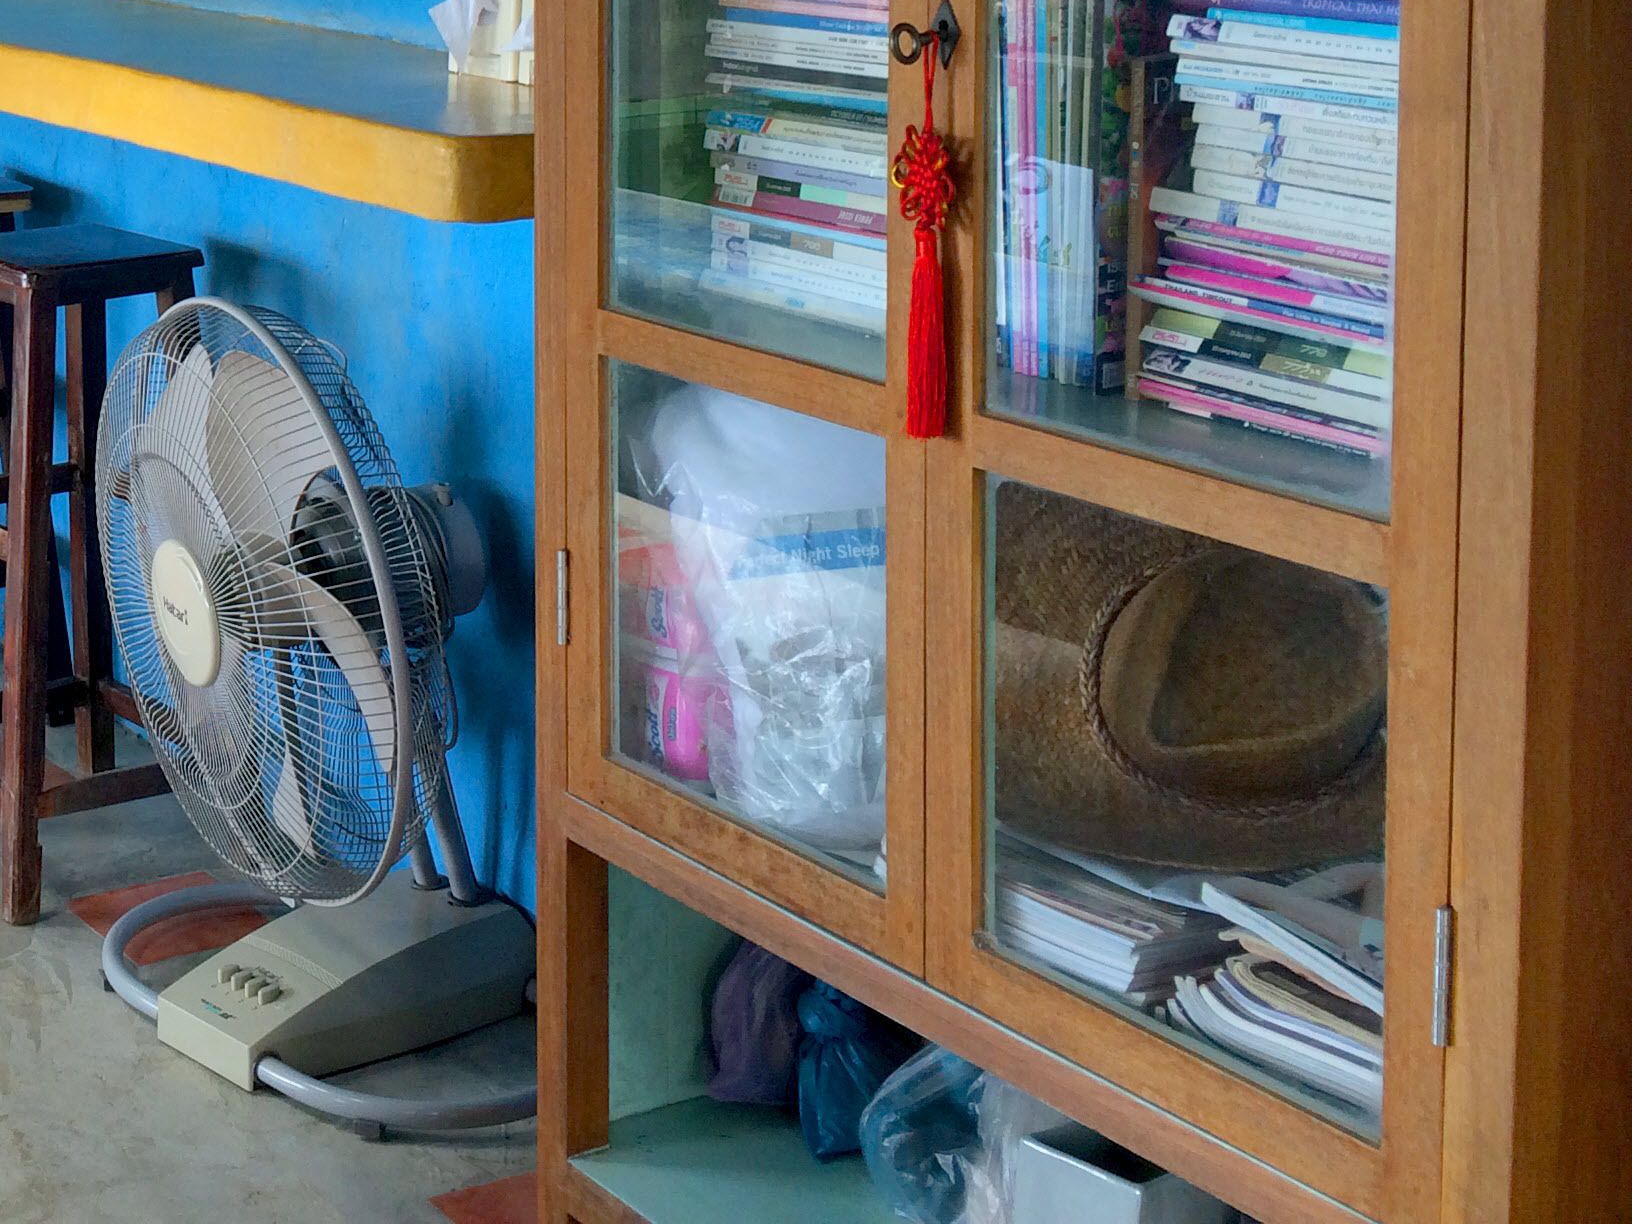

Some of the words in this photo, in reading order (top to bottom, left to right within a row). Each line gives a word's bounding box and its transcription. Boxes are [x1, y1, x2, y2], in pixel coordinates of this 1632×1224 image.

[1357, 2, 1382, 15] THAI
[791, 548, 832, 564] Night
[836, 544, 880, 560] Sleep
[651, 586, 667, 639] Scott
